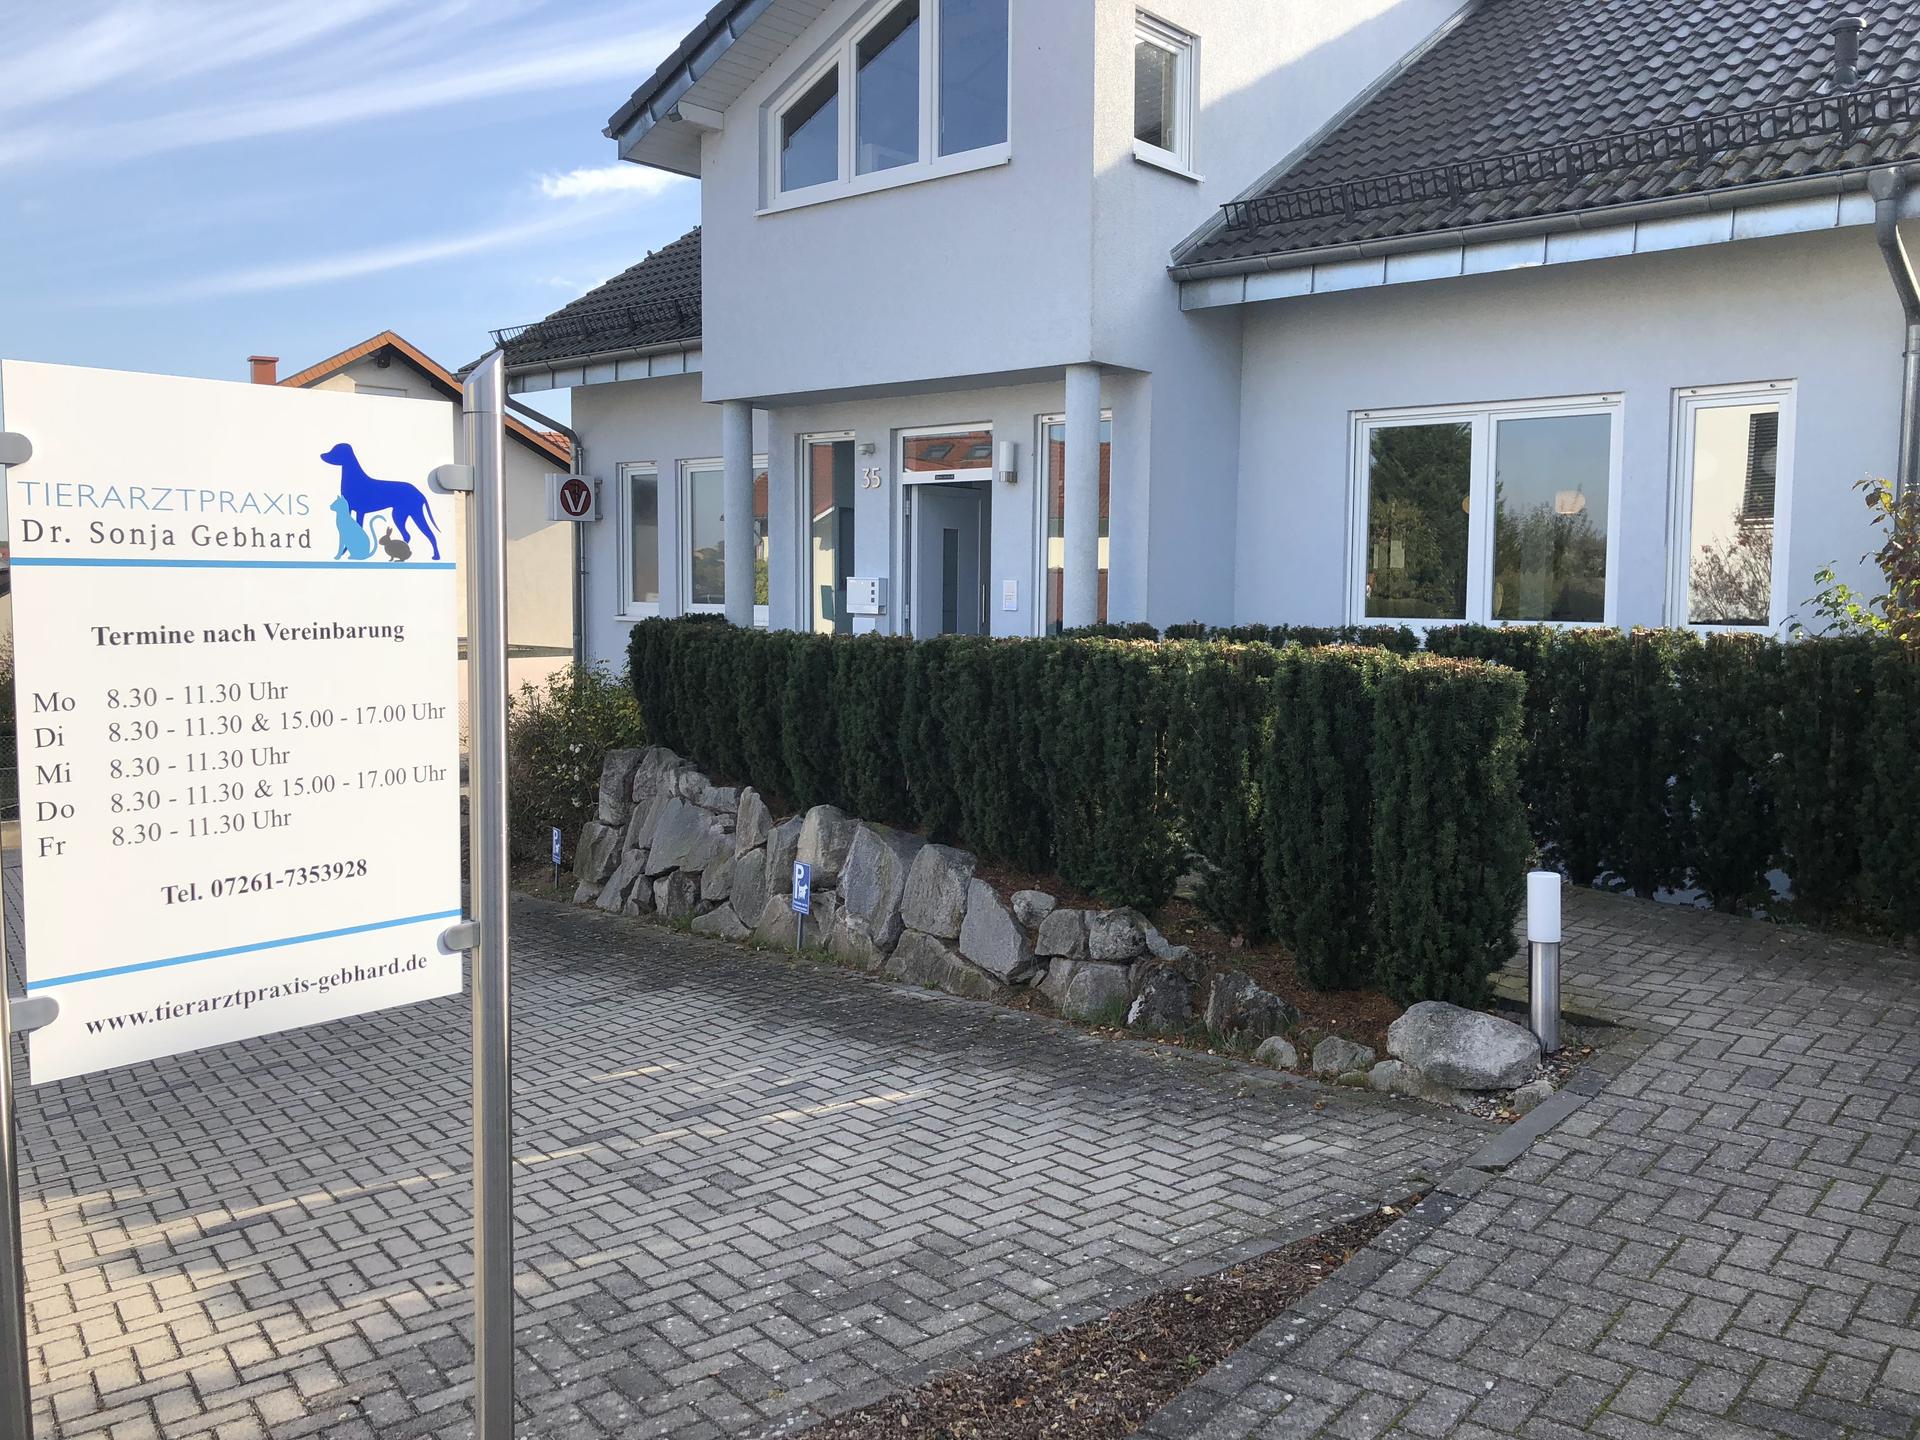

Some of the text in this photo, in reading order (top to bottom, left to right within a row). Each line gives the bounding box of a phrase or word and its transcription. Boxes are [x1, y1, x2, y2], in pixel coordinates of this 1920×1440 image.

[862, 467, 881, 489] 35
[18, 481, 310, 516] TIERARZTPRAXIS
[563, 489, 588, 513] V
[22, 518, 312, 552] Dr. Sonja Gebhard
[91, 621, 405, 647] Termine nach Vereinbarung
[32, 691, 76, 714] Mo
[107, 687, 158, 710] 8.30
[184, 682, 242, 705] 11.30
[248, 680, 289, 701] Uhr
[34, 725, 65, 749] Di
[108, 719, 159, 743] 8.30
[185, 714, 243, 737] 11.30
[250, 712, 271, 733] &
[281, 708, 334, 730] 15.00
[356, 704, 406, 725] 17.00
[411, 702, 447, 721] Uhr
[36, 761, 73, 786] Mi
[110, 756, 160, 780] 8.30
[186, 749, 244, 773] 11.30
[250, 746, 291, 767] Uhr
[36, 801, 75, 823] Do
[110, 789, 161, 814] 8.30
[187, 781, 244, 806] 11.30
[254, 779, 274, 799] &
[282, 774, 336, 797] 15.00
[358, 767, 407, 789] 17.00
[412, 764, 447, 784] Uhr
[37, 836, 67, 858] Fr
[111, 822, 162, 847] 8.30
[188, 812, 245, 838] 11.30
[251, 808, 292, 830] Uhr
[160, 858, 368, 905] Tel. 07261-7353928
[793, 863, 804, 899] P
[85, 953, 428, 1035] www.tierarztpraxis-gebhard.de
